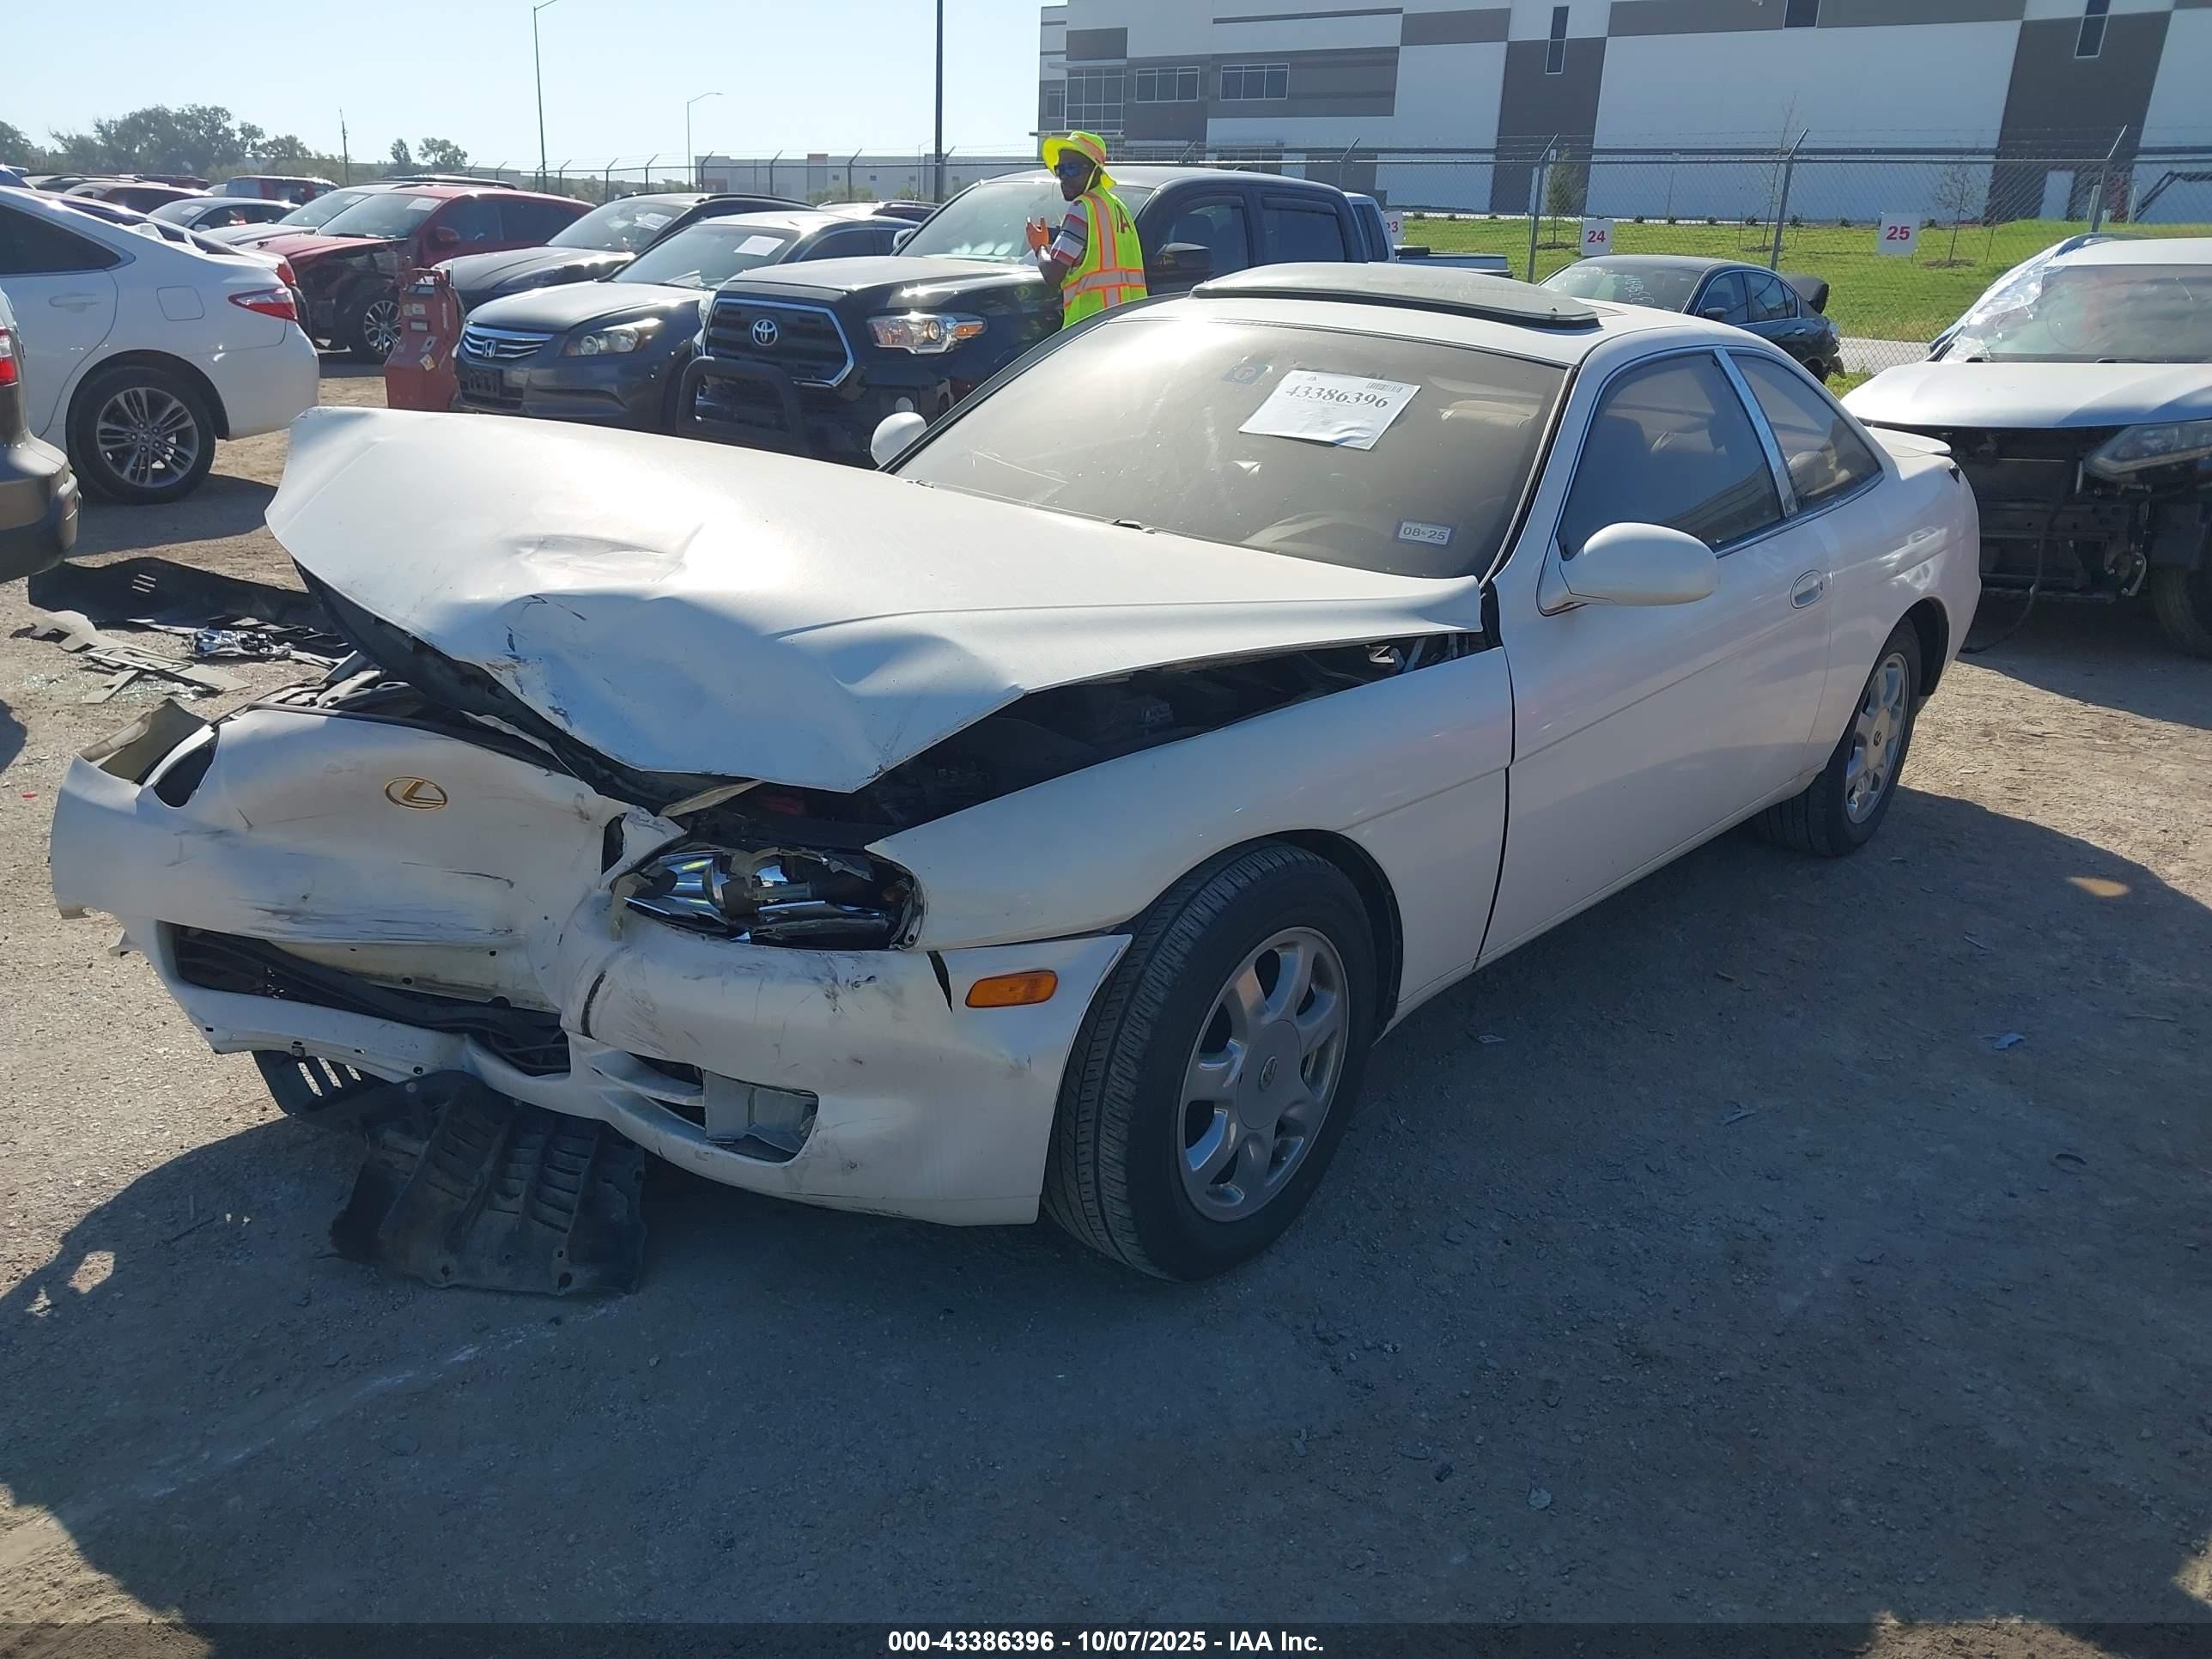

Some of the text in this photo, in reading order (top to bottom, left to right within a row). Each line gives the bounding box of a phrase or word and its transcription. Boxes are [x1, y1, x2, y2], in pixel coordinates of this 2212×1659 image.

[1587, 230, 1607, 243] 24
[1886, 225, 1911, 240] 25
[1285, 385, 1395, 409] 43386396
